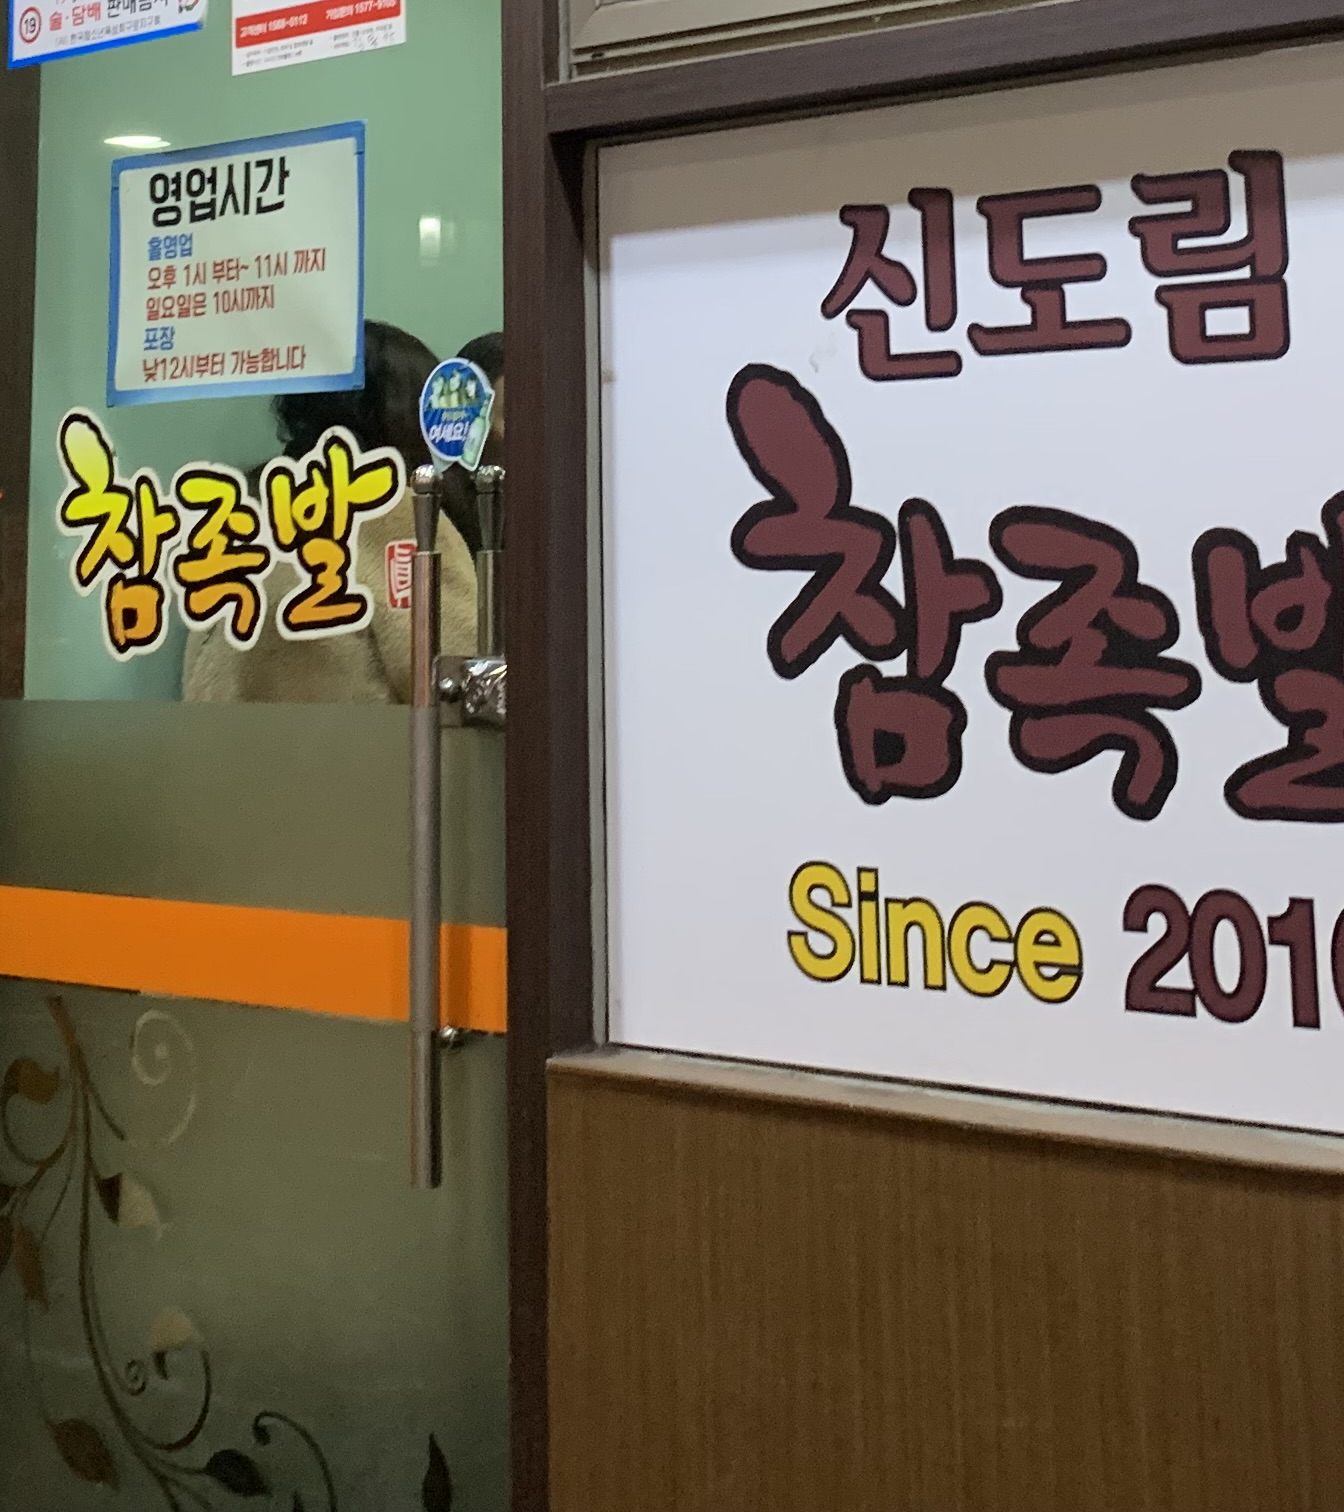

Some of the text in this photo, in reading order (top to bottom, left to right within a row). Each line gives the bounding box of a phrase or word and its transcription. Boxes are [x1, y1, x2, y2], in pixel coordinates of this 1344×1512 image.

[23, 16, 36, 35] 19
[149, 156, 290, 228] 영업시간
[147, 233, 193, 261] 홀영업
[146, 264, 177, 290] 오후
[183, 261, 207, 287] 1시
[821, 149, 1291, 381] 신도림
[145, 284, 275, 321] 일요일은 10시까지
[143, 326, 175, 351] 포장
[230, 344, 307, 375] 가능합니다
[61, 413, 400, 654] 참족발
[787, 861, 1084, 1004] Since
